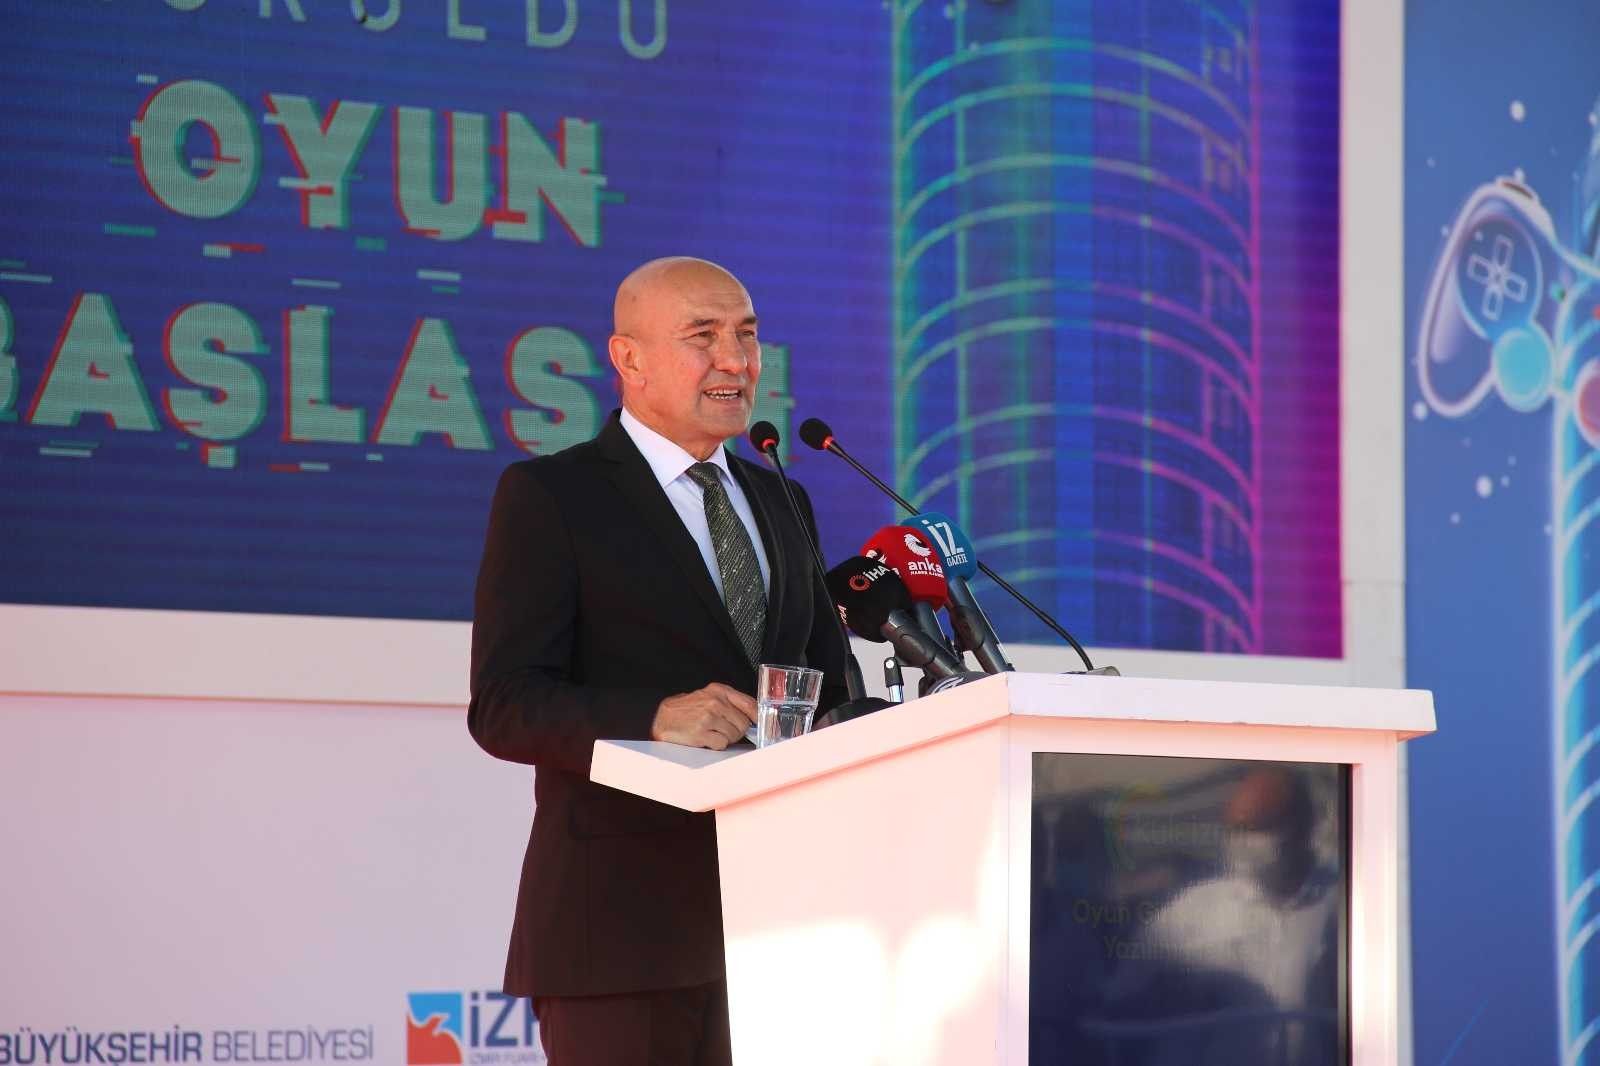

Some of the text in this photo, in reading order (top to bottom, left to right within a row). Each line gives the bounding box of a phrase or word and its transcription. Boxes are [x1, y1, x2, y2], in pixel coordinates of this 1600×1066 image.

[130, 79, 606, 248] OYUN
[907, 557, 944, 574] anka
[946, 553, 969, 567] GAZETE
[212, 1024, 373, 1062] BELEDİYESİ
